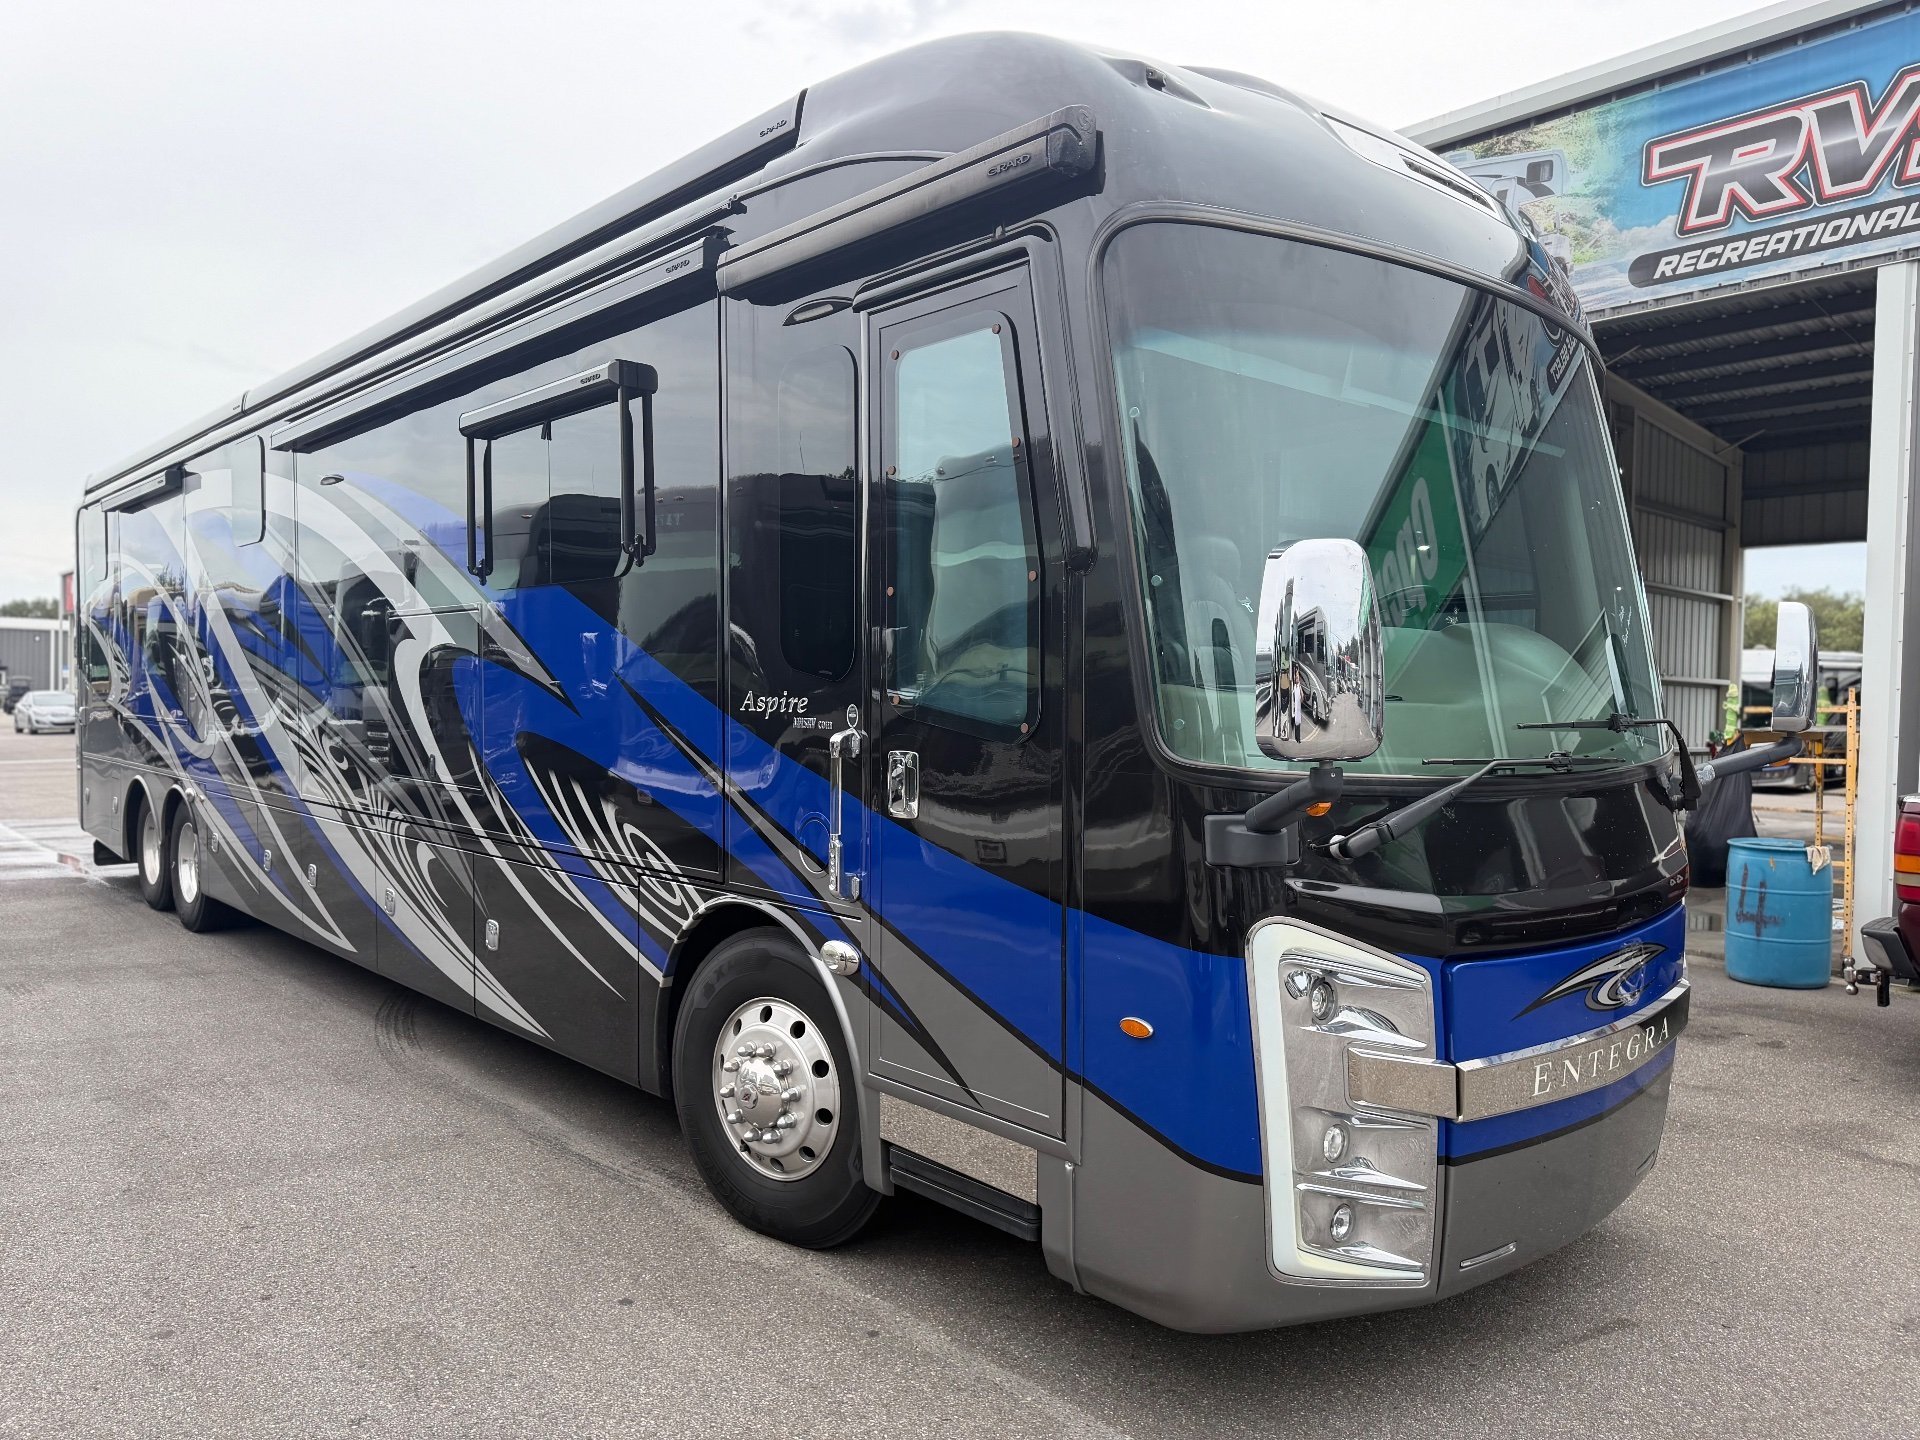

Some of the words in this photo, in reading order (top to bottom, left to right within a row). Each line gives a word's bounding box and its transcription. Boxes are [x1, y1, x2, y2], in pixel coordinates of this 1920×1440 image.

[1653, 203, 1920, 280] RECREATIONAL
[739, 690, 809, 720] Aspire
[1735, 863, 1786, 938] 4
[1531, 1016, 1670, 1097] ENTEGRA
